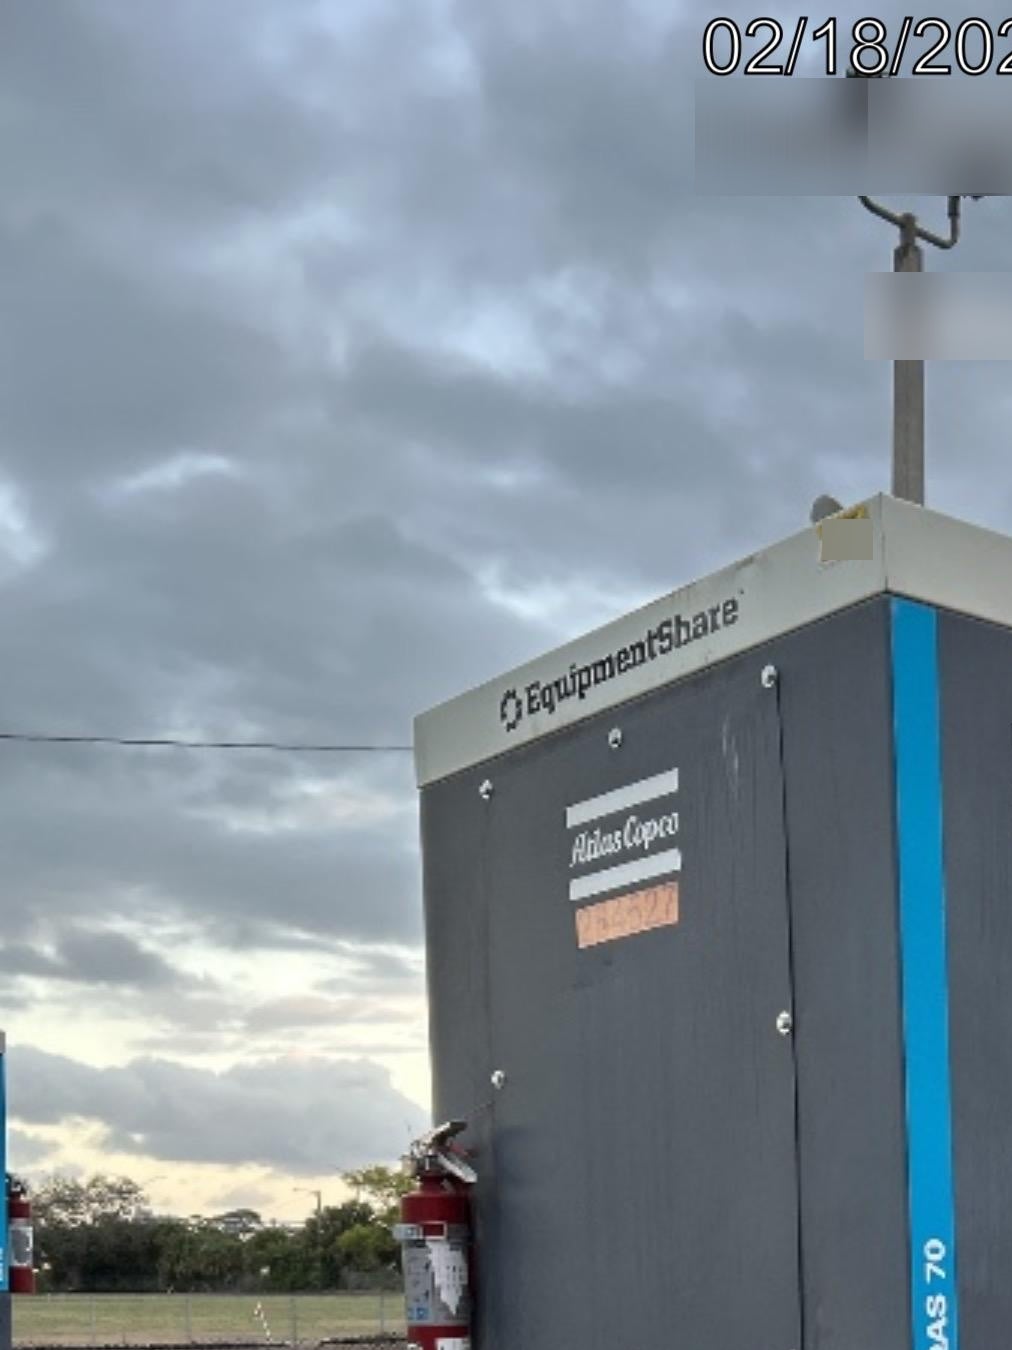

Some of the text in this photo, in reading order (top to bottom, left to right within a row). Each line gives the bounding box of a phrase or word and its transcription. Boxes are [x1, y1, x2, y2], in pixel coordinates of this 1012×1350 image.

[525, 597, 740, 714] EquipmentShare
[568, 812, 679, 868] Atlas Copco
[923, 1237, 947, 1285] 70
